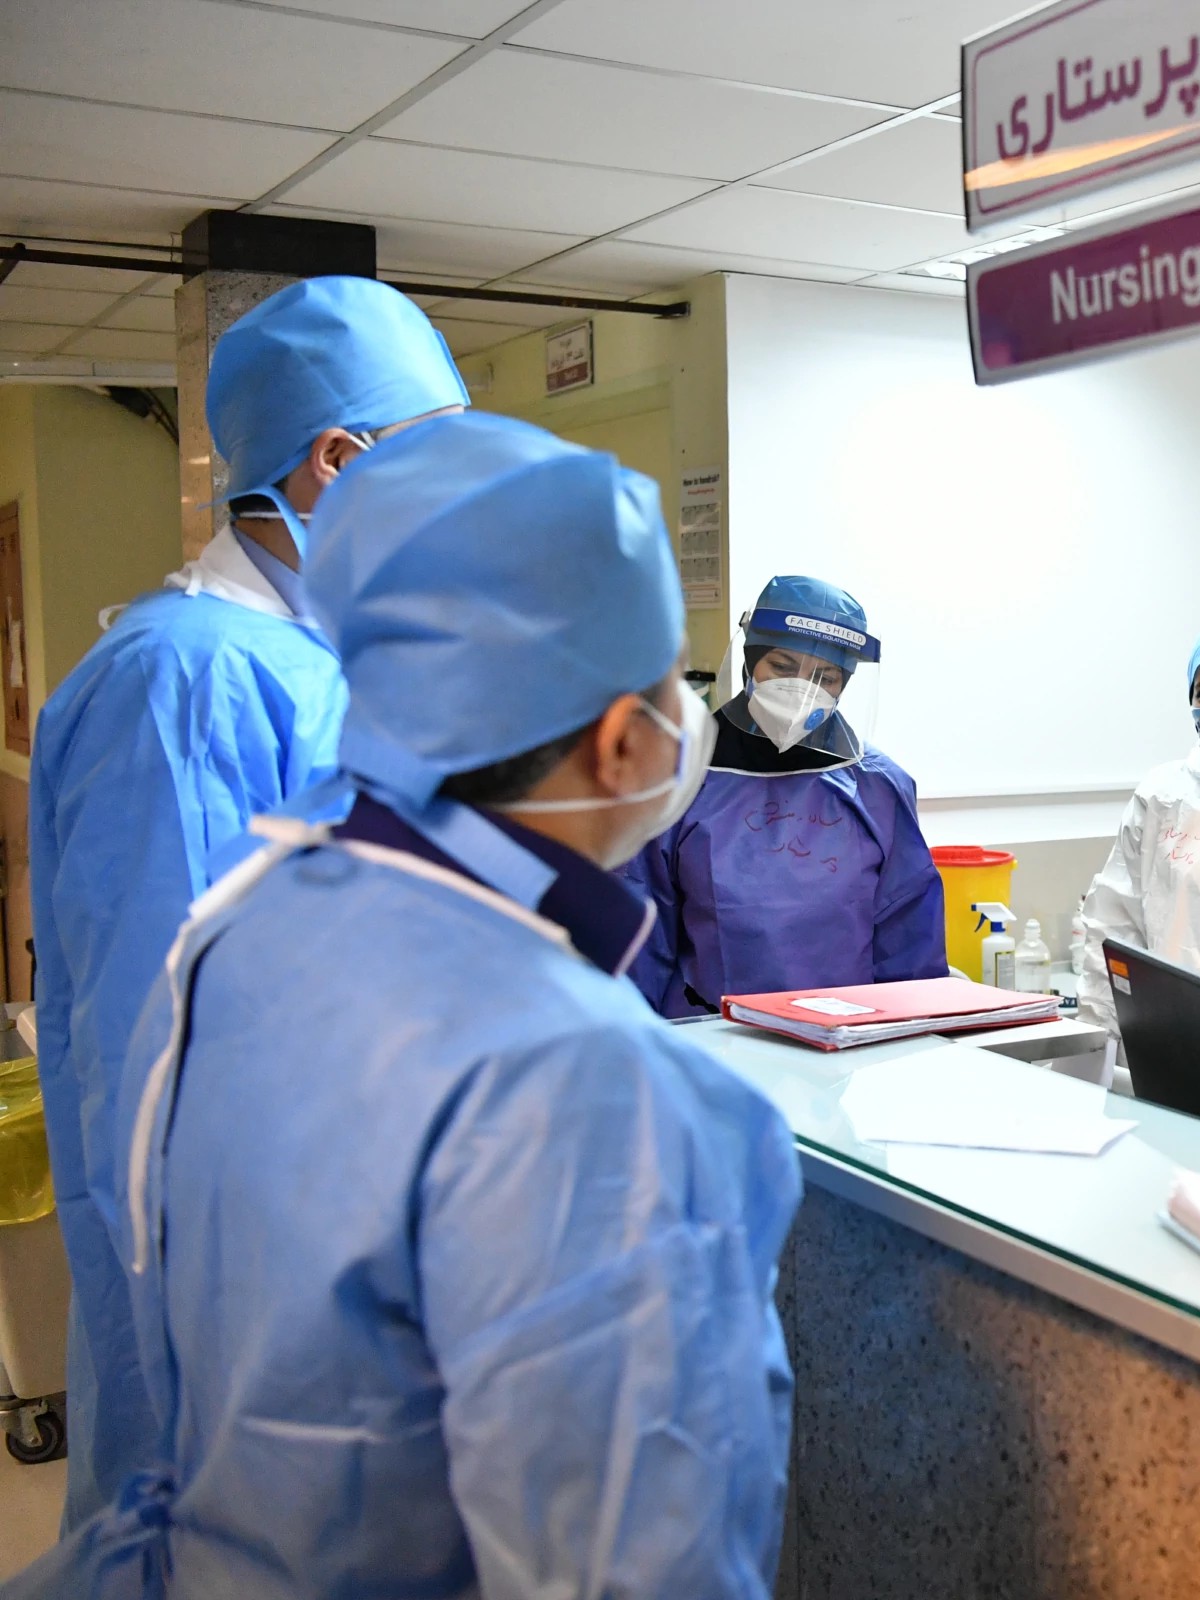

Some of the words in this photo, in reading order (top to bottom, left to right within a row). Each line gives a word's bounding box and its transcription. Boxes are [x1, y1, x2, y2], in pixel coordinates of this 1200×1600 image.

[996, 38, 1200, 161] پرستاری
[789, 627, 821, 637] PROTECTIVE
[822, 634, 849, 646] ISOLATION
[790, 617, 821, 630] FACE
[825, 625, 863, 643] SHIELD
